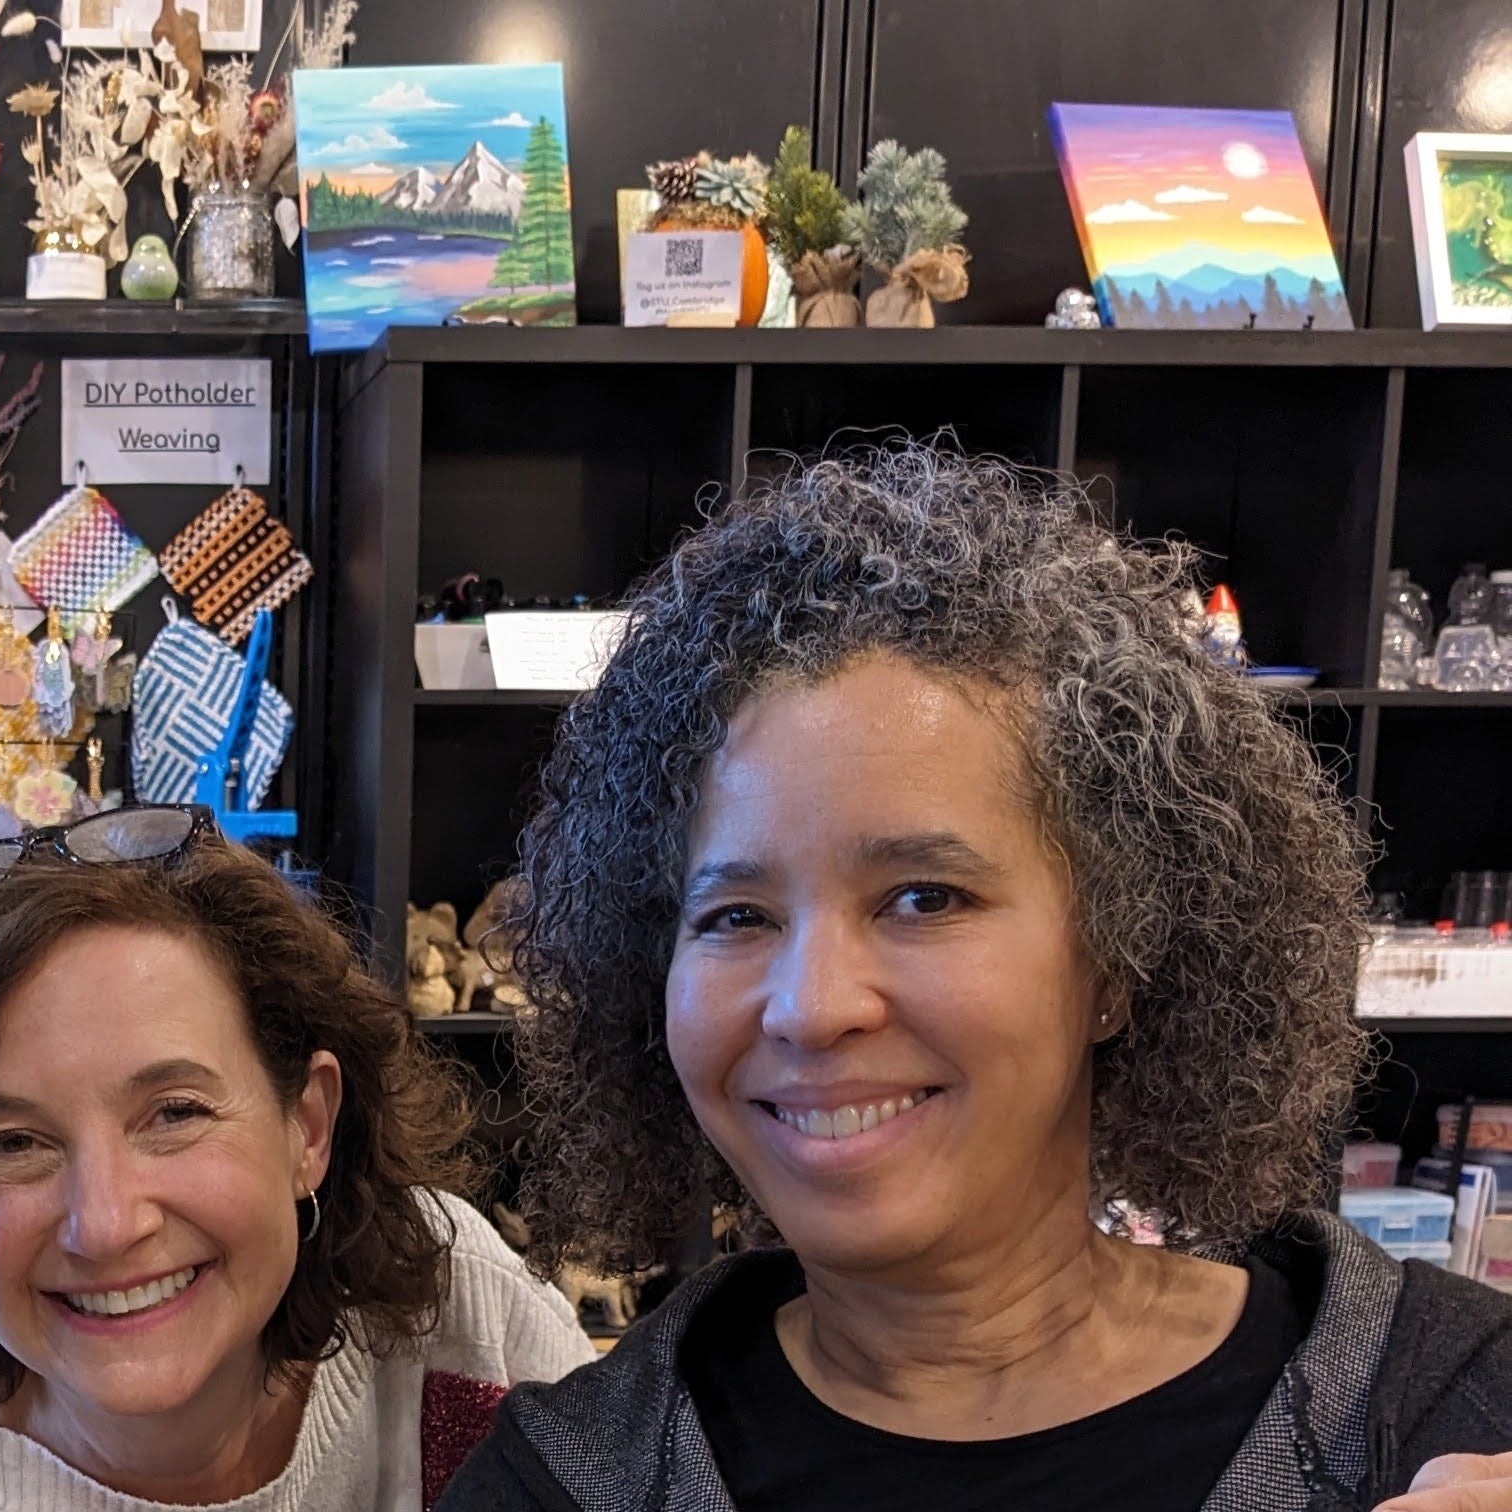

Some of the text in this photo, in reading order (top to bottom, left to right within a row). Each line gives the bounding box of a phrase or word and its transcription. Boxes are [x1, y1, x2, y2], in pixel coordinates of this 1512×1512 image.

[84, 382, 256, 405] DIY Potholder
[118, 428, 221, 453] Weaving
